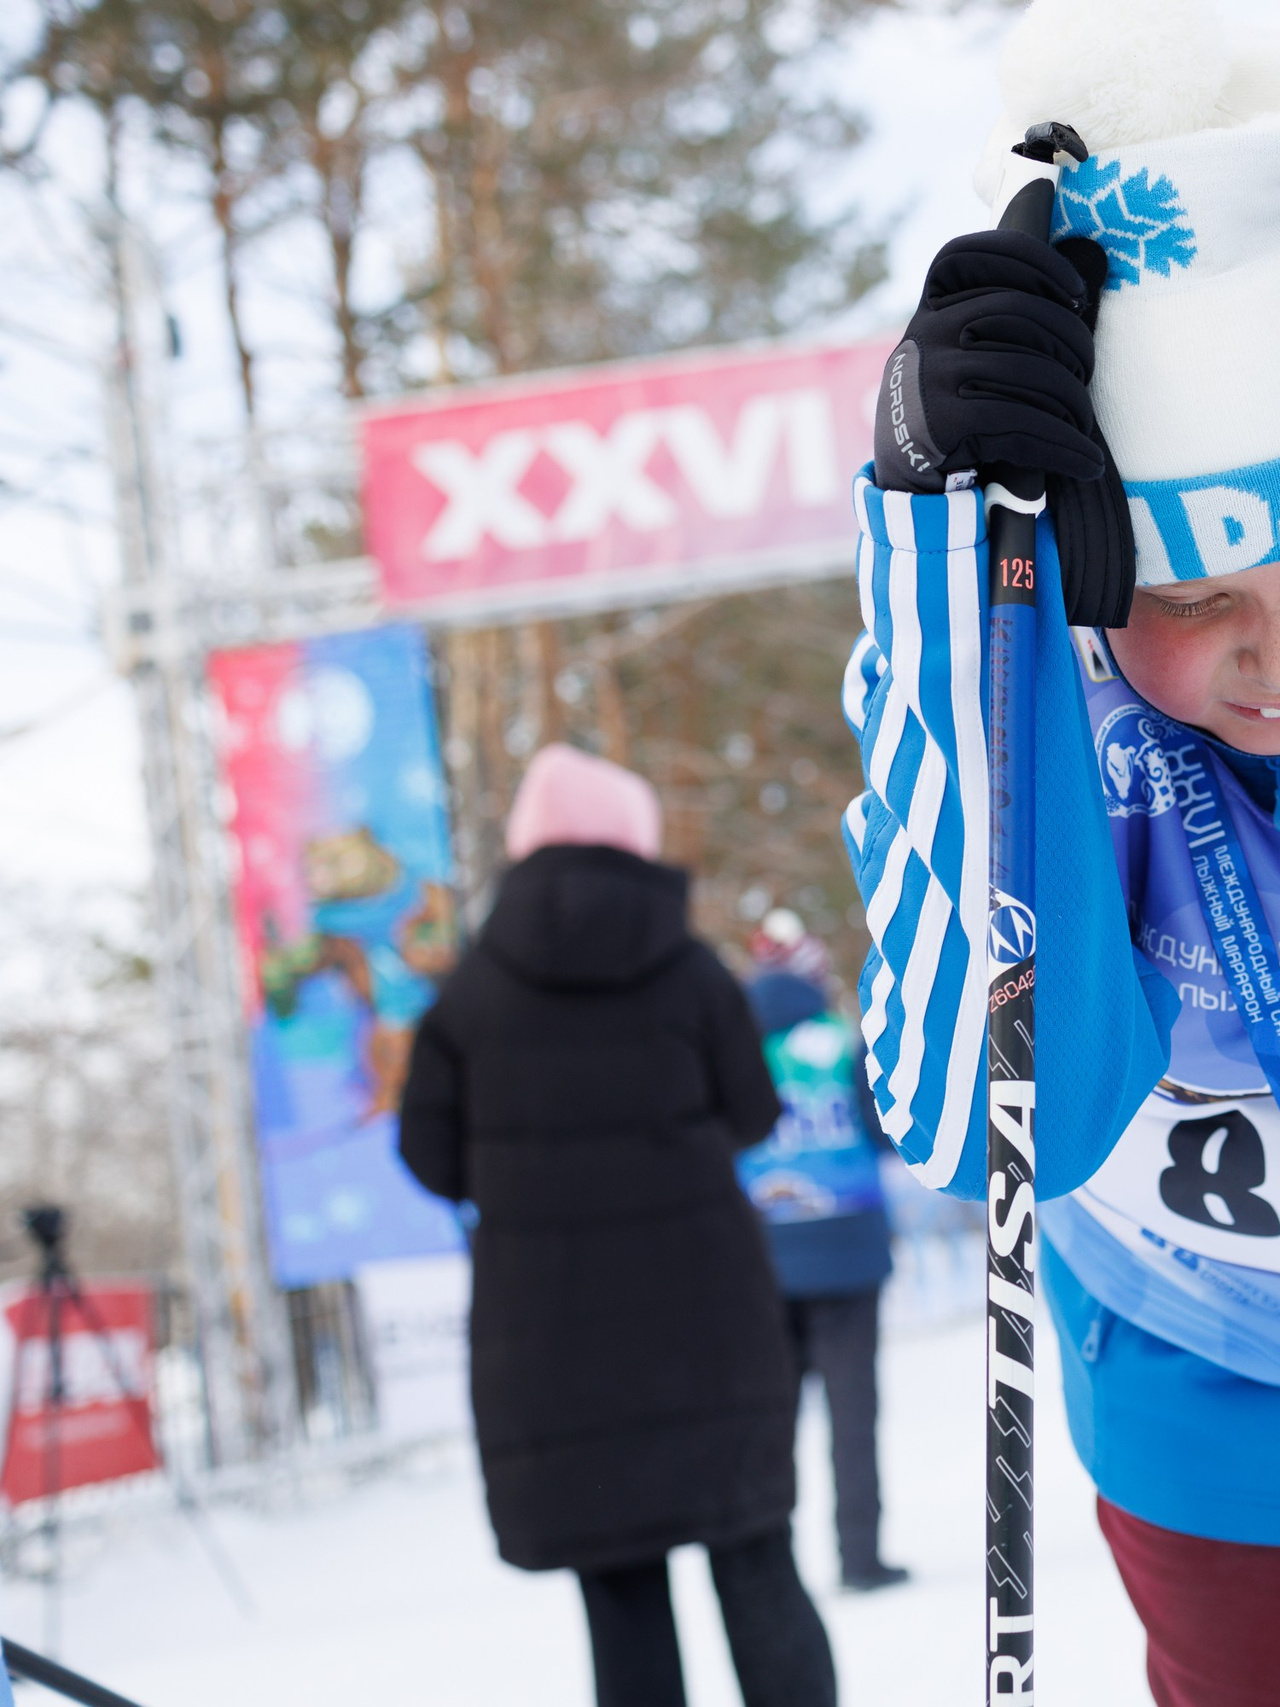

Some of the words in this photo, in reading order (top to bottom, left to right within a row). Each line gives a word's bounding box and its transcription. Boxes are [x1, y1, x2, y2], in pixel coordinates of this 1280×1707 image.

[889, 353, 930, 472] NORDSKI
[411, 388, 838, 565] XXVI
[1000, 557, 1034, 590] 125
[1165, 743, 1226, 849] XXVI
[988, 965, 1036, 1014] Z6042
[1193, 854, 1236, 932] ЛЫЖНЫЙ
[1221, 934, 1264, 1024] МАРАФОН
[988, 1080, 1036, 1411] TISA
